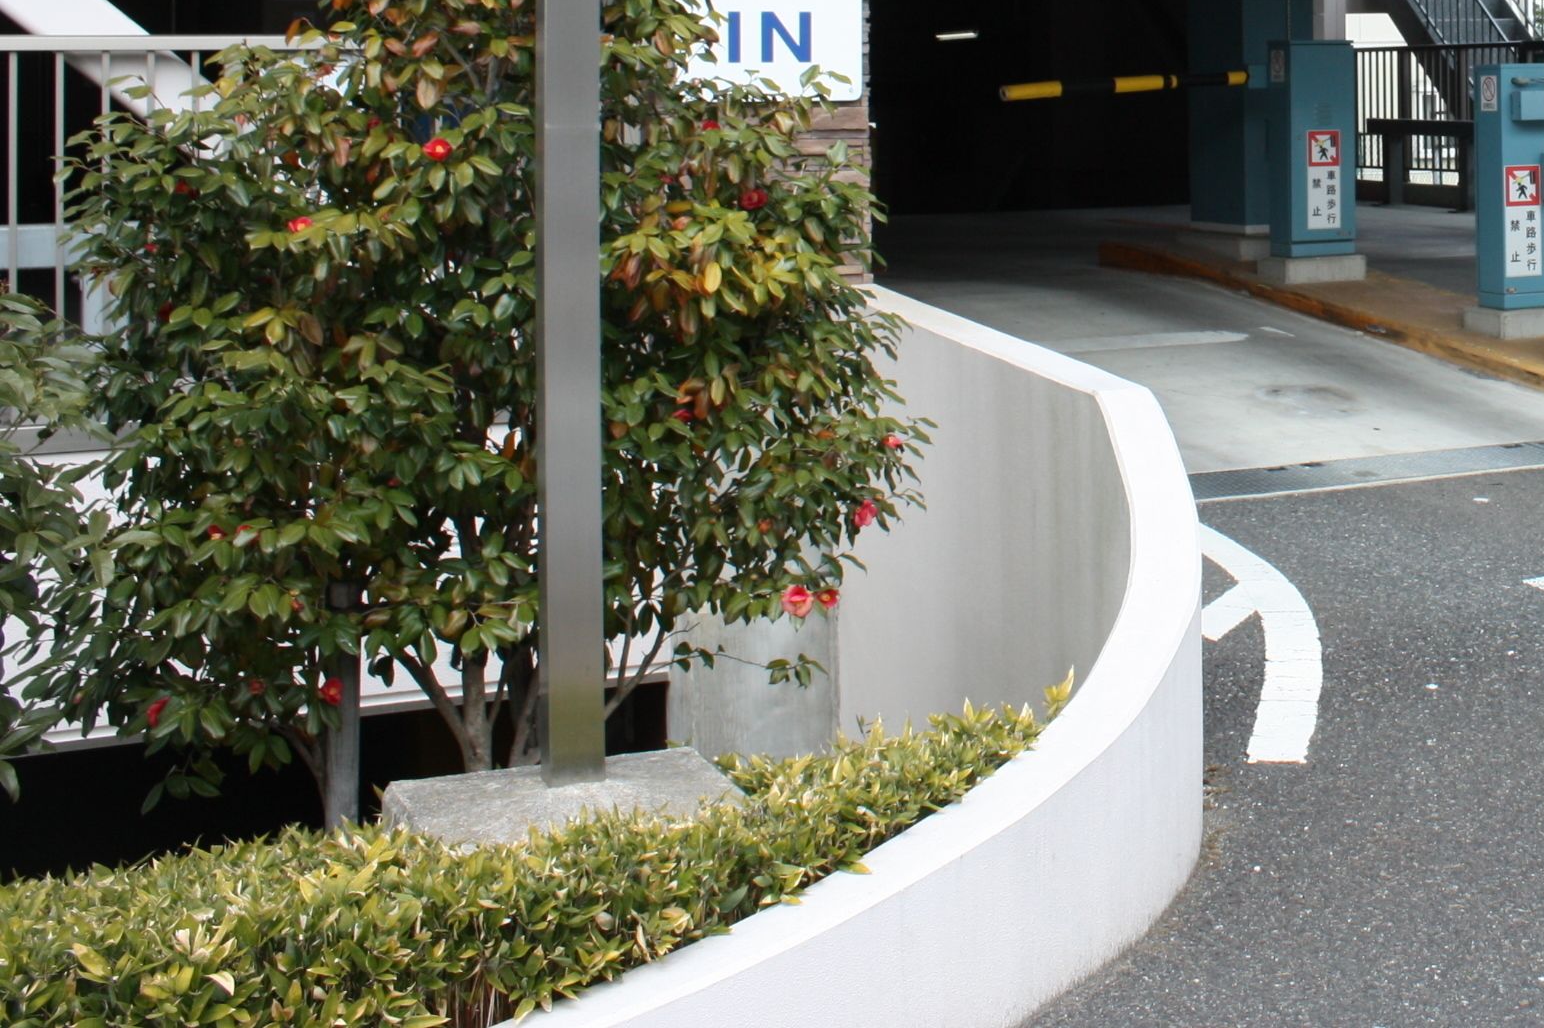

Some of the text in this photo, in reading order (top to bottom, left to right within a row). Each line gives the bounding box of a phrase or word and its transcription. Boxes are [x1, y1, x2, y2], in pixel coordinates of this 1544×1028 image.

[727, 10, 812, 63] IN
[1312, 178, 1323, 217] 禁止
[1325, 170, 1337, 224] 車路歩行
[1510, 219, 1521, 263] 禁止
[1526, 210, 1537, 272] 車路歩行
